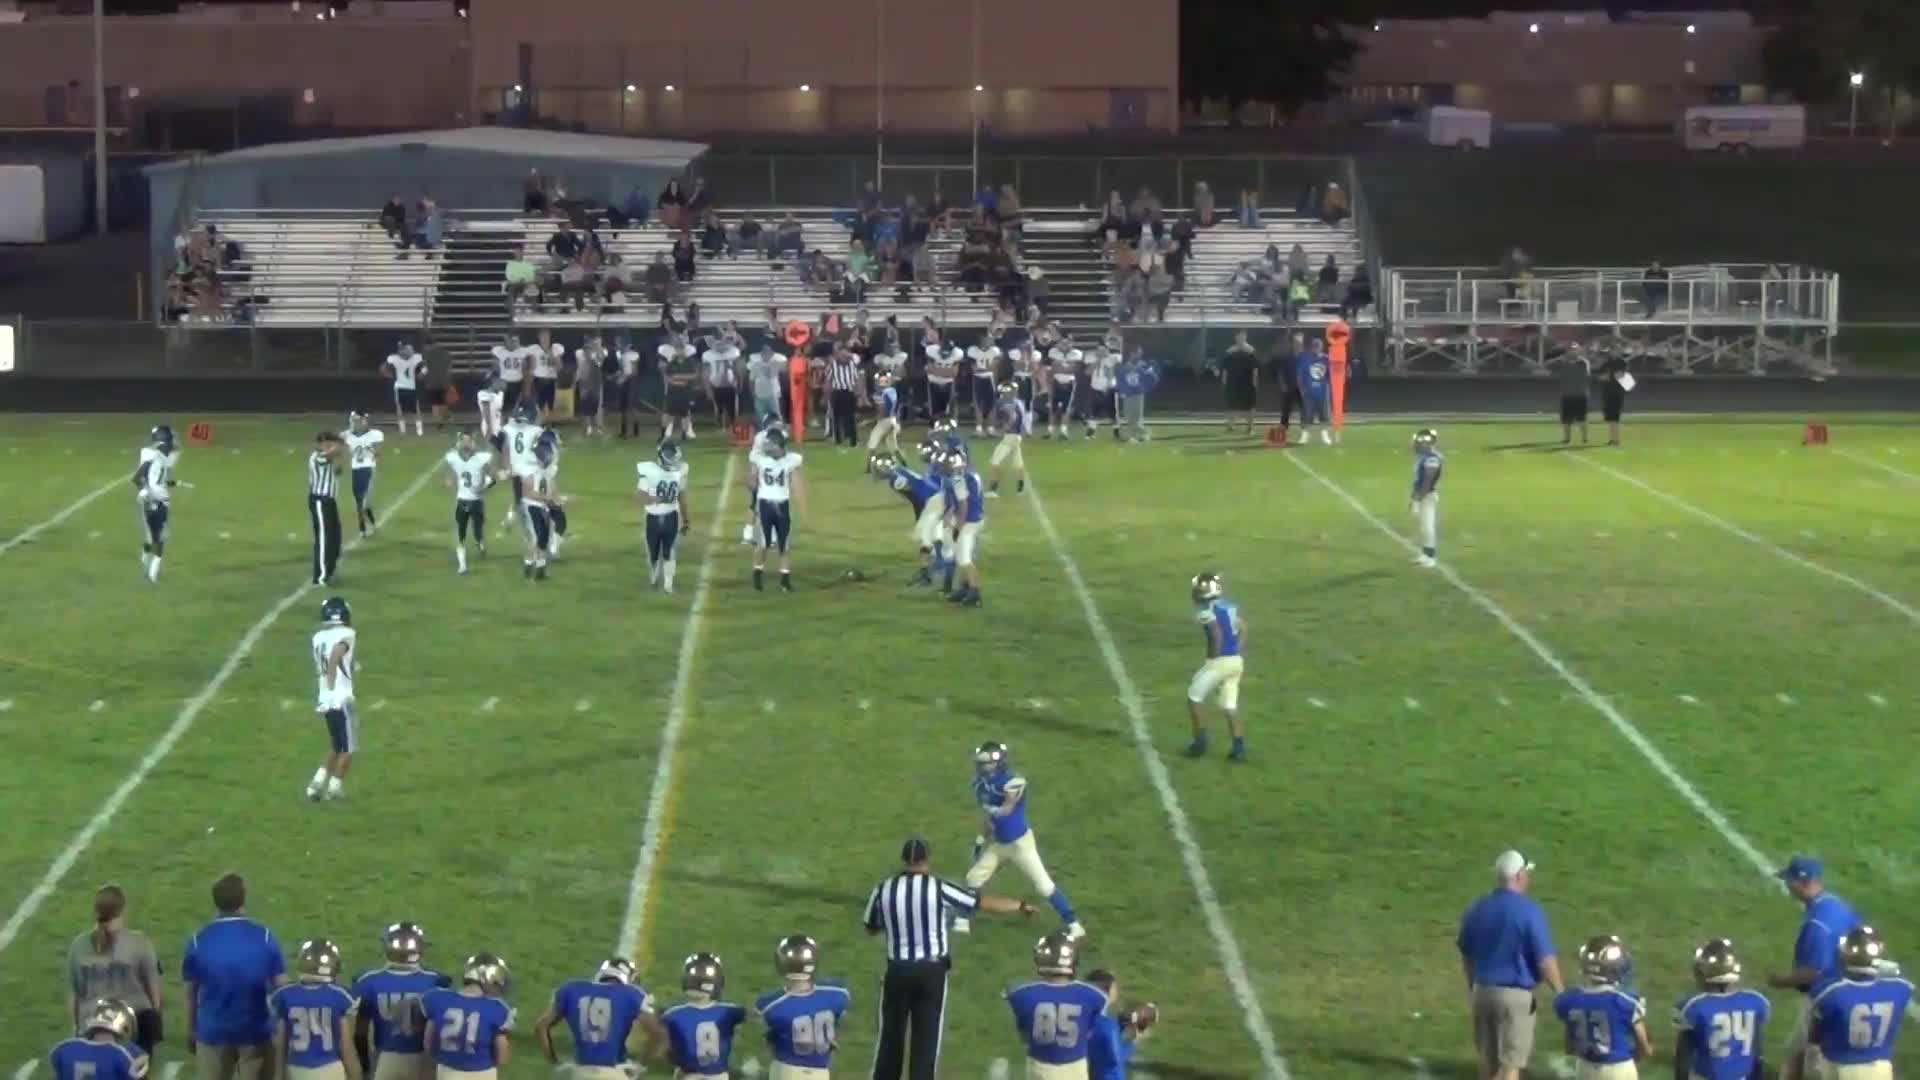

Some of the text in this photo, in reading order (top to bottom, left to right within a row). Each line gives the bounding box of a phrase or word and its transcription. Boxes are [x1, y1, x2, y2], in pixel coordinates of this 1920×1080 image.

[192, 424, 209, 441] 40
[514, 432, 524, 454] 6
[462, 470, 472, 489] 3
[287, 1006, 332, 1052] 34
[440, 1008, 480, 1054] 21
[1033, 1002, 1082, 1048] 85
[1708, 1011, 1754, 1057] 24
[1849, 1002, 1894, 1049] 67
